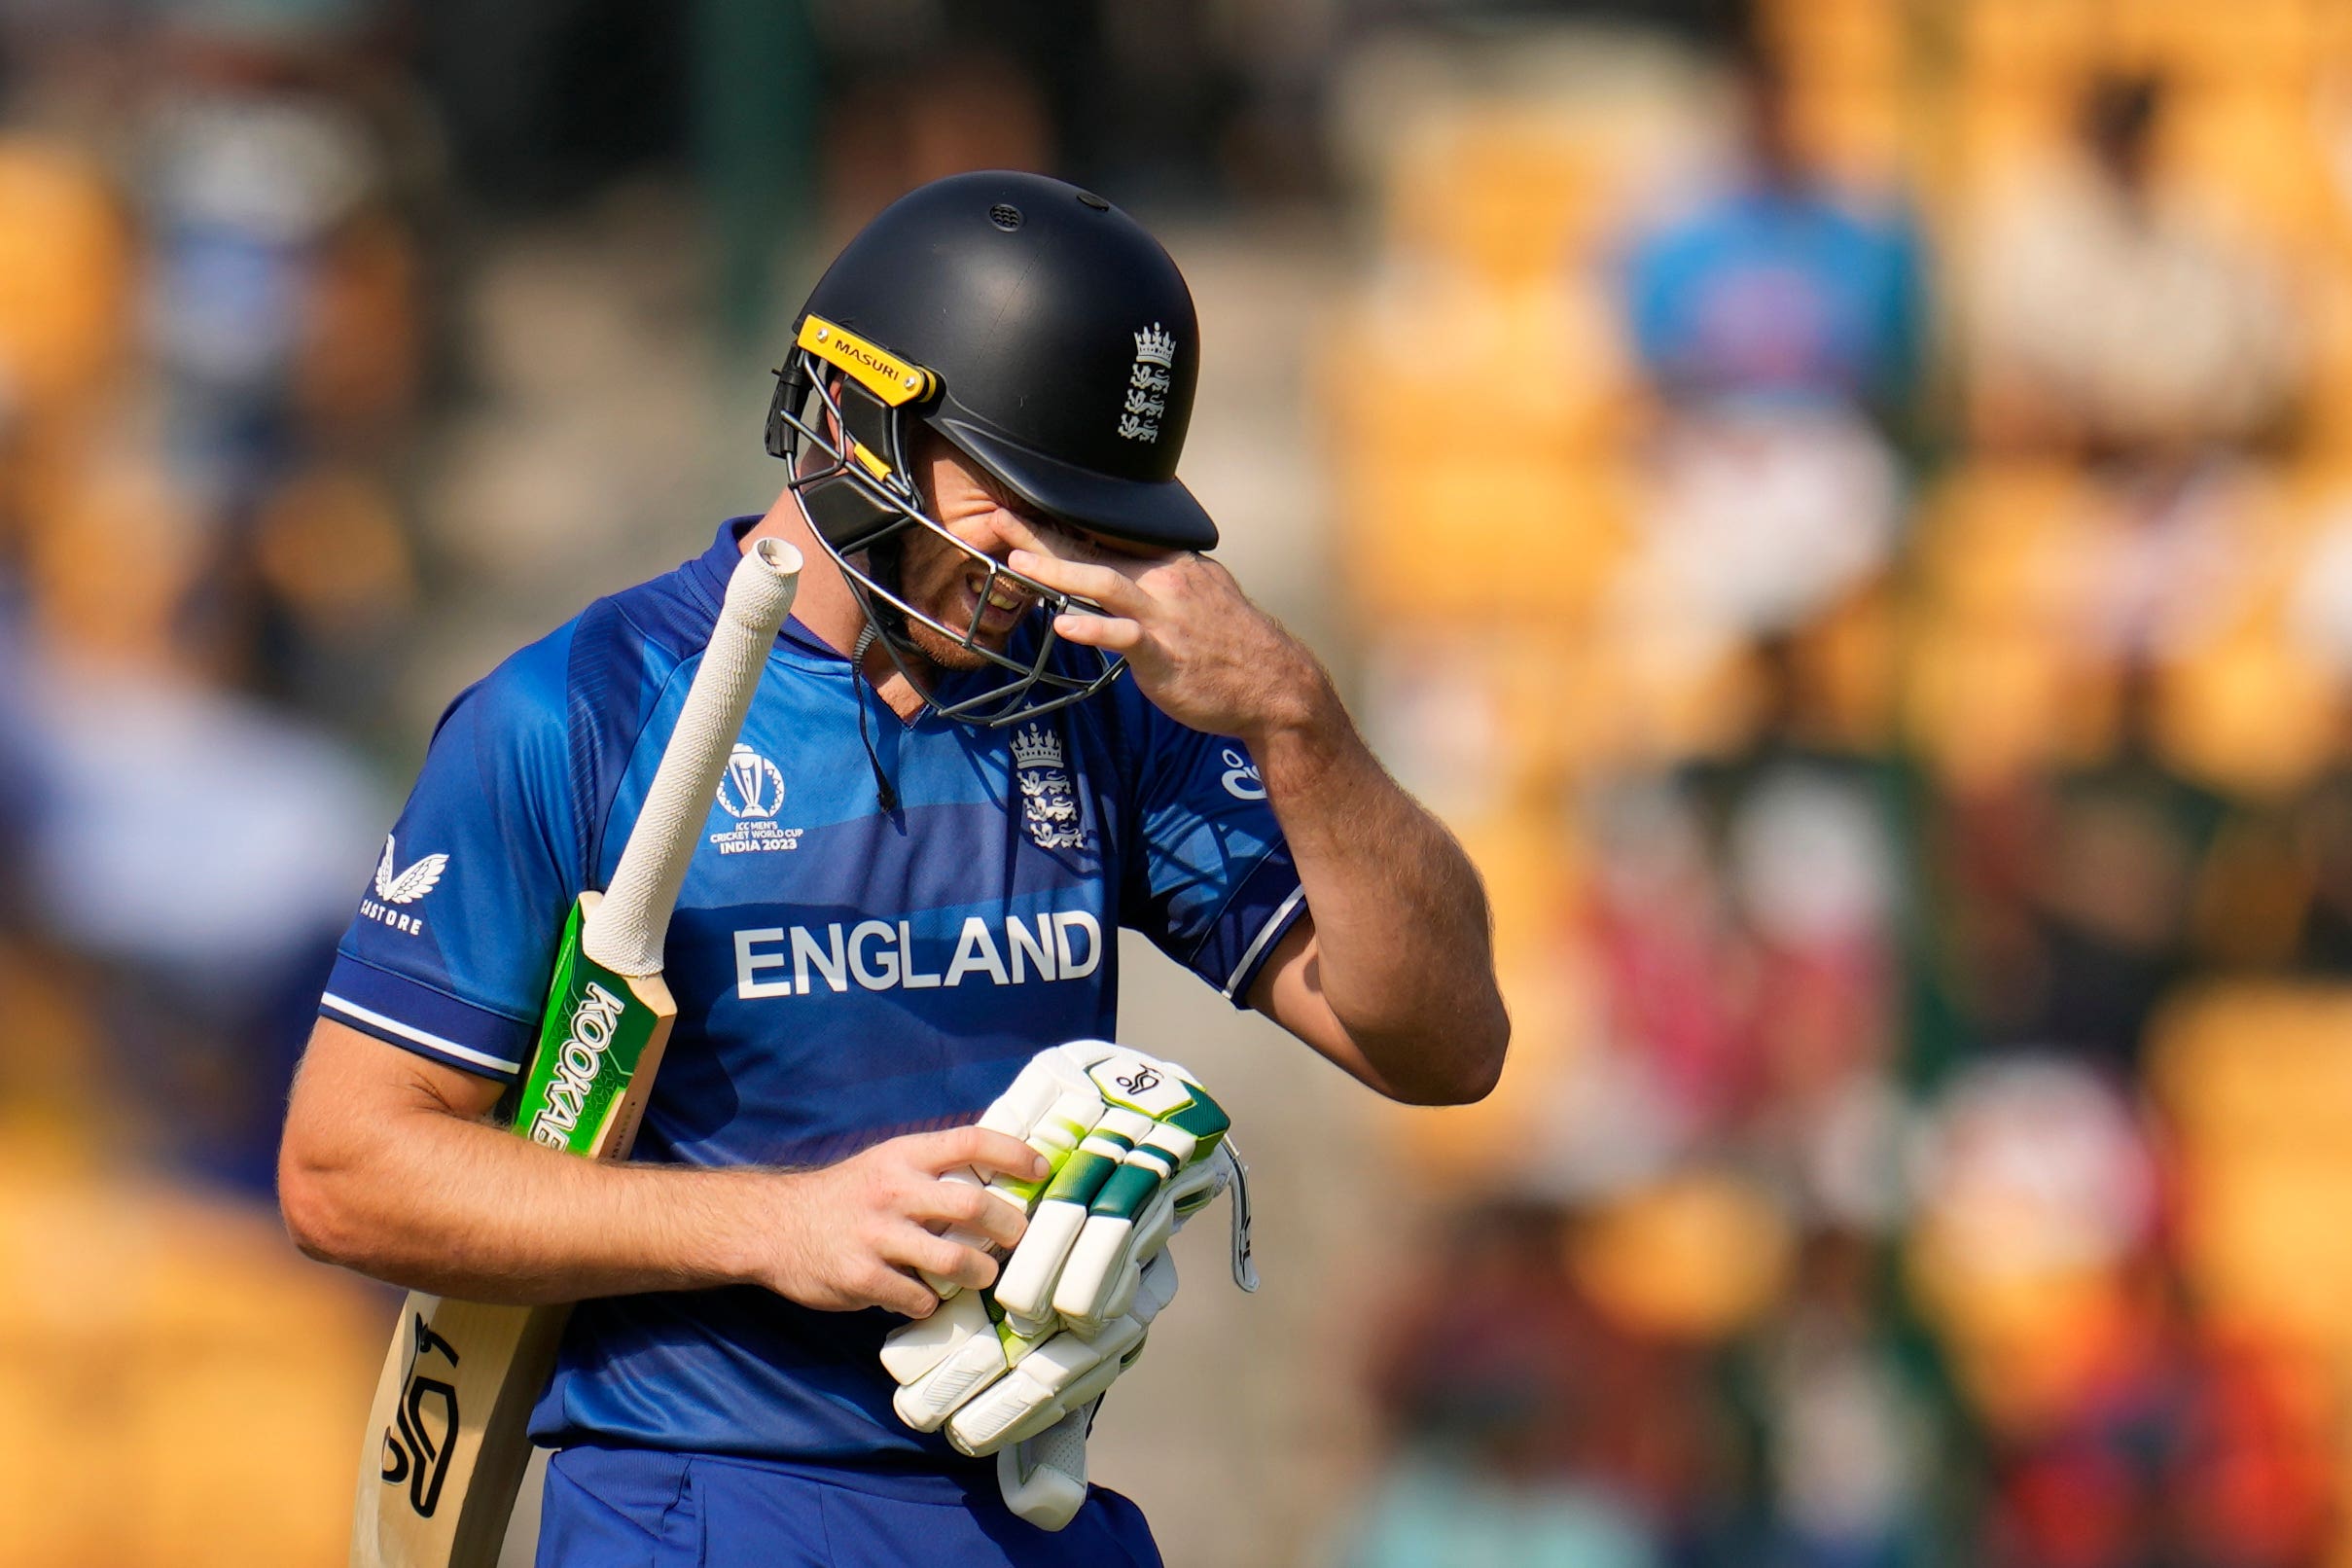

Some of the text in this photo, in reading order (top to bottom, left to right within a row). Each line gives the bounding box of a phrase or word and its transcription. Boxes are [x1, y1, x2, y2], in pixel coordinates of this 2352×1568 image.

[835, 339, 900, 380] MASURI
[735, 821, 778, 831] ICC MEN'S
[710, 828, 804, 844] CRICKET WORLD CUP
[720, 838, 797, 854] INDIA 2023
[733, 910, 1102, 1000] ENGLAND
